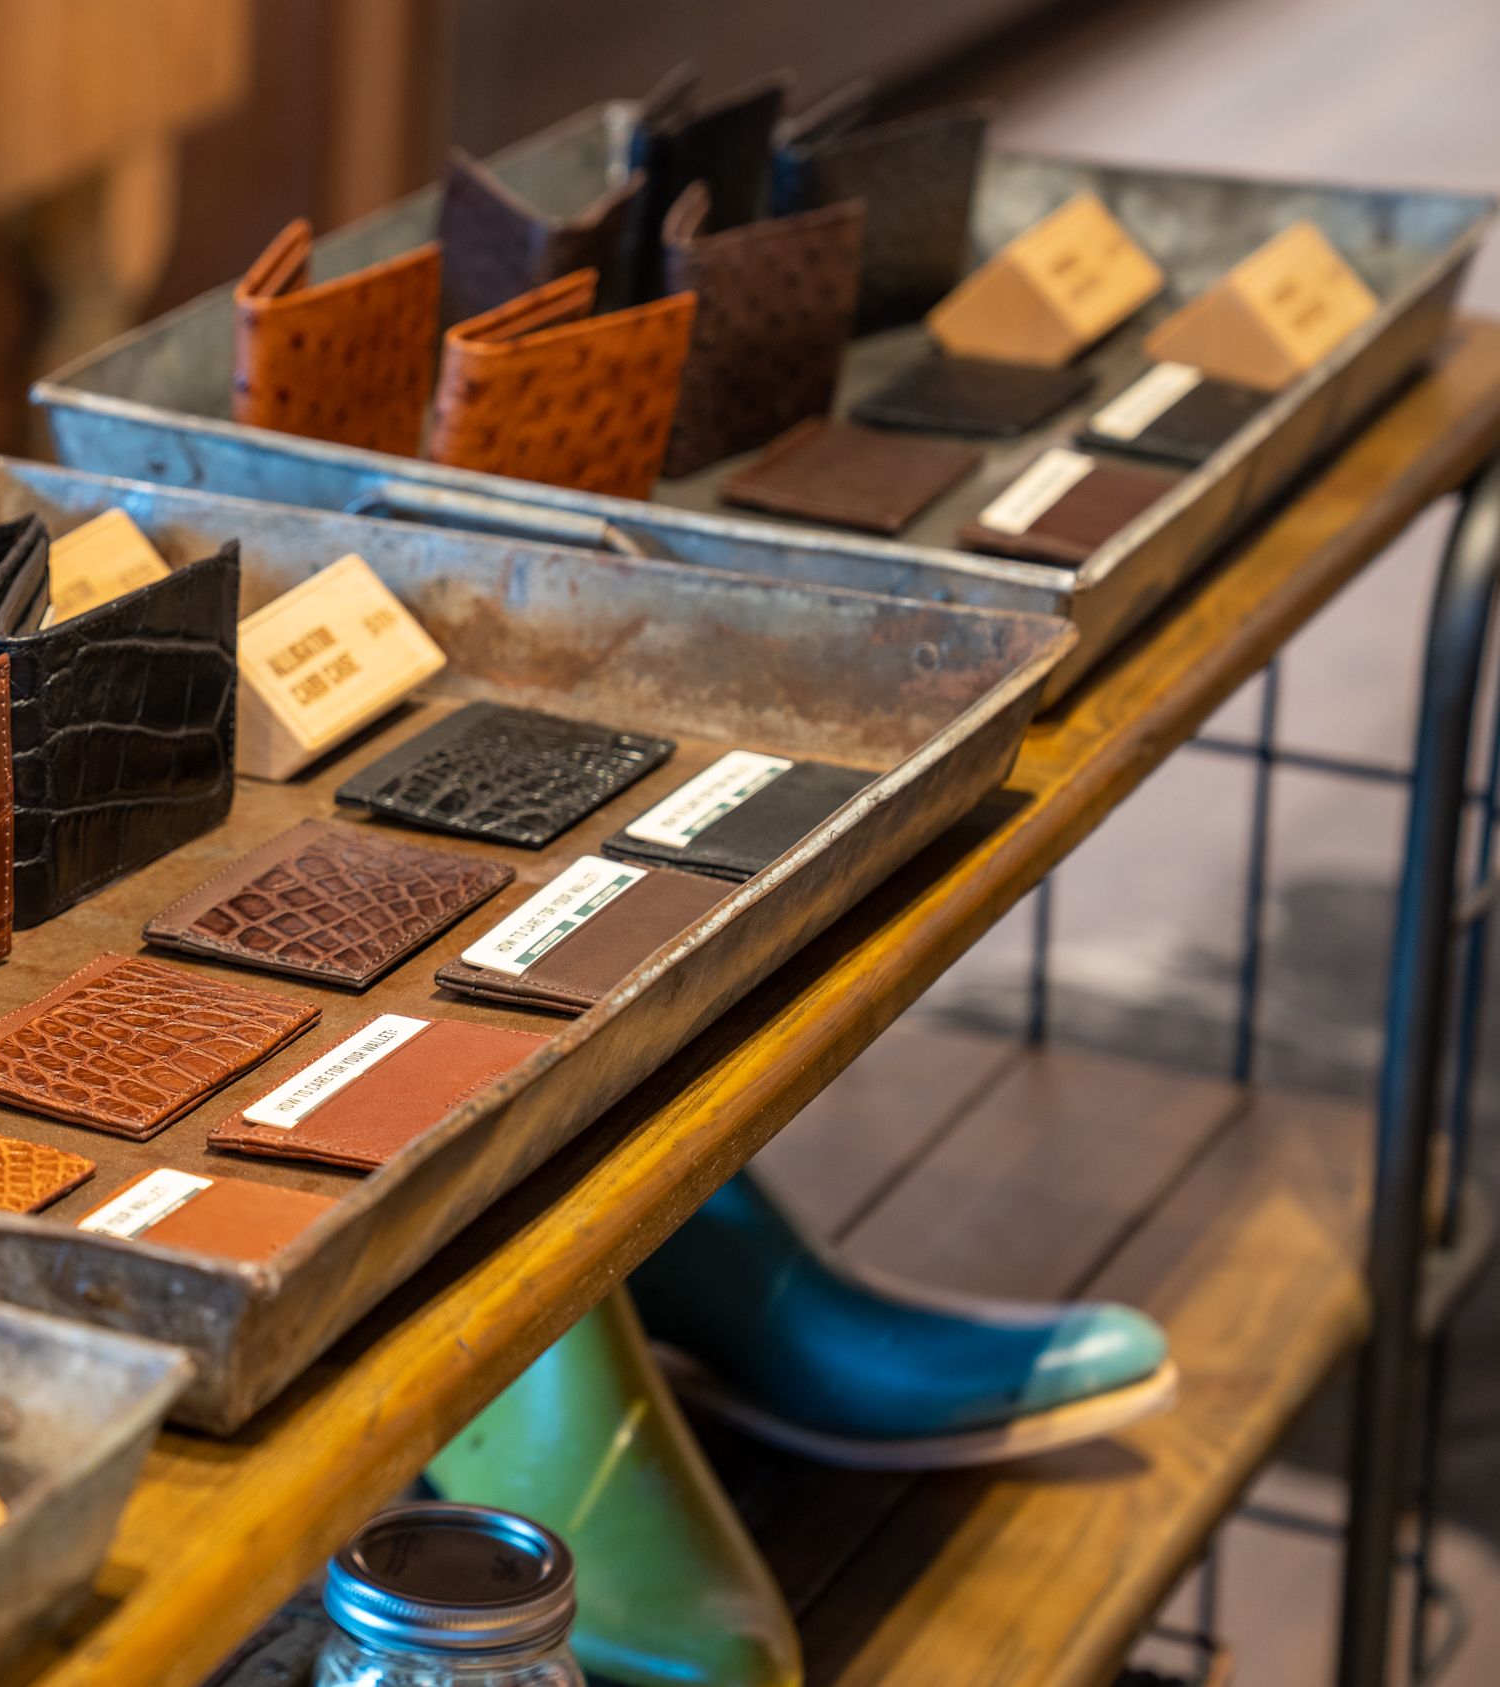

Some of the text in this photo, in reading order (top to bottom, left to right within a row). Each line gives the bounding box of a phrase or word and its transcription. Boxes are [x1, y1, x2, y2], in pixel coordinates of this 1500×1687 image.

[273, 1095, 303, 1112] HOW
[292, 1087, 314, 1099] TO
[303, 1074, 334, 1091] CARE
[323, 1063, 350, 1077] FOR
[338, 1050, 369, 1066] YOUR
